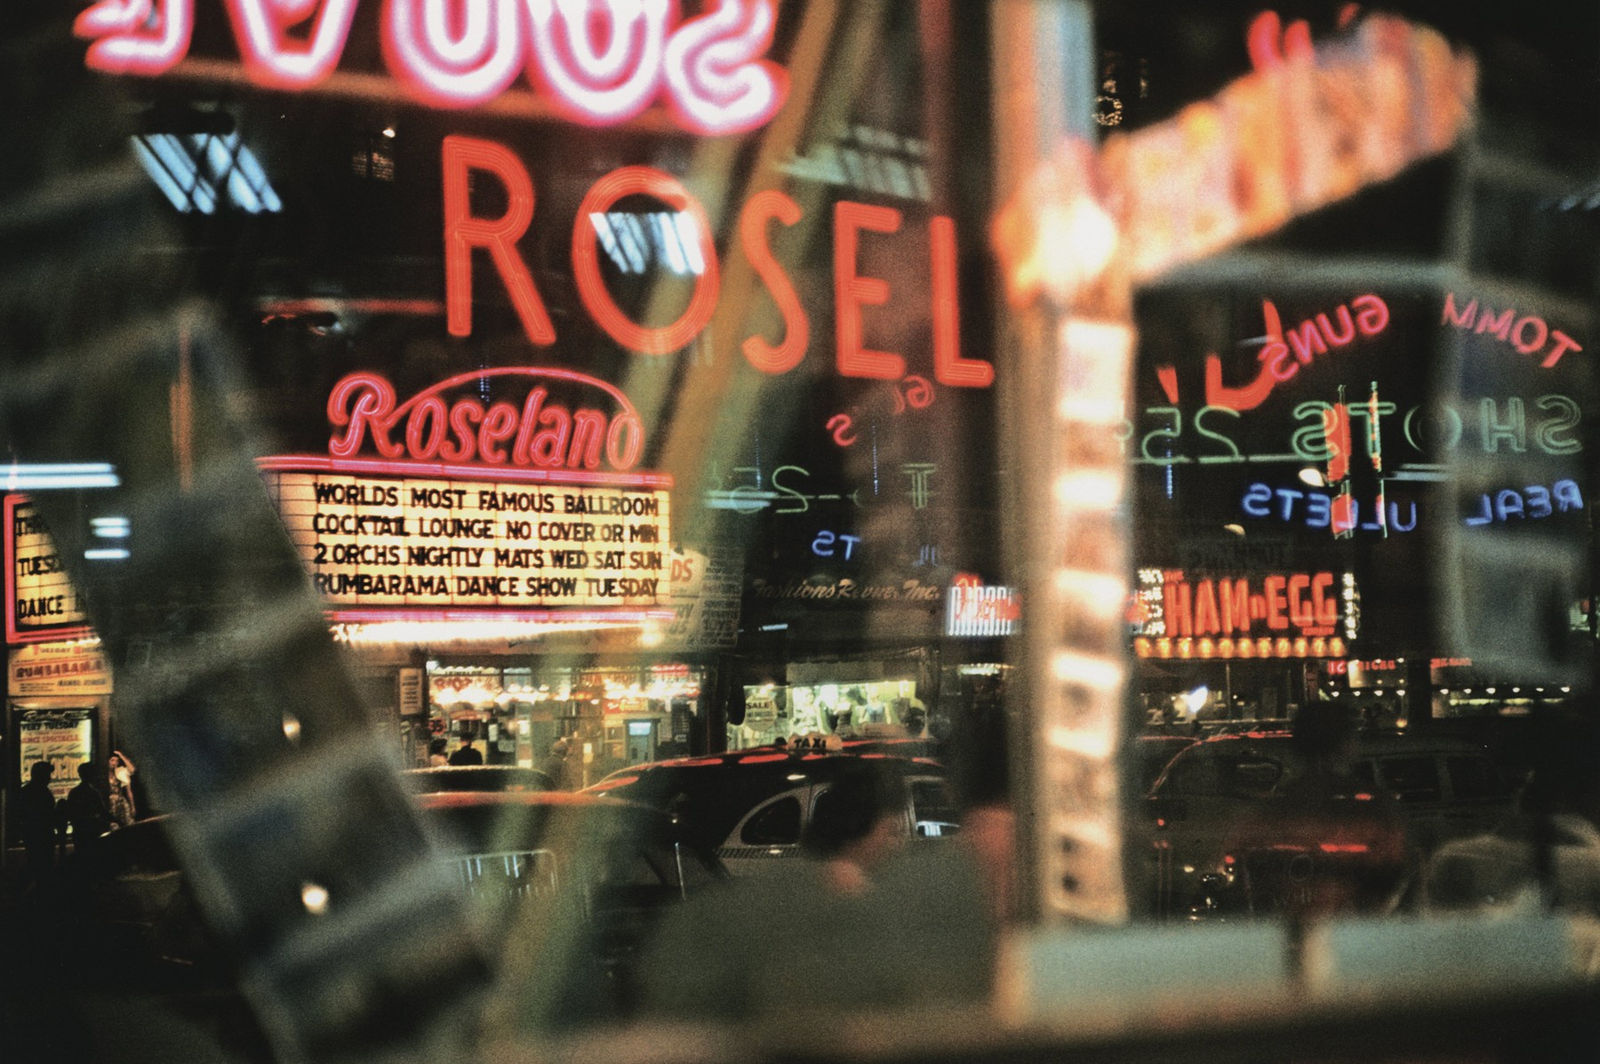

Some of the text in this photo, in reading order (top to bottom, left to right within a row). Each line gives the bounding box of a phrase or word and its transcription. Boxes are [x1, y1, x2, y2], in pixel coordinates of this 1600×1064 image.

[442, 134, 994, 387] ROSEL
[326, 366, 645, 472] Roseland
[313, 482, 659, 517] WORLDS MOST FAMOUS BALLROOM
[313, 512, 659, 543] COCKTAIL LOUNGE NO COVER OR MIN
[313, 542, 663, 571] 2 ORCHS NIGHTLY MATS WED SAT SUN
[671, 558, 694, 582] DS
[313, 573, 659, 598] RUMBARAMA DANCE SHOW TUESDAY
[18, 595, 64, 619] DANCE
[745, 700, 769, 710] SALE
[793, 737, 827, 754] TAXI
